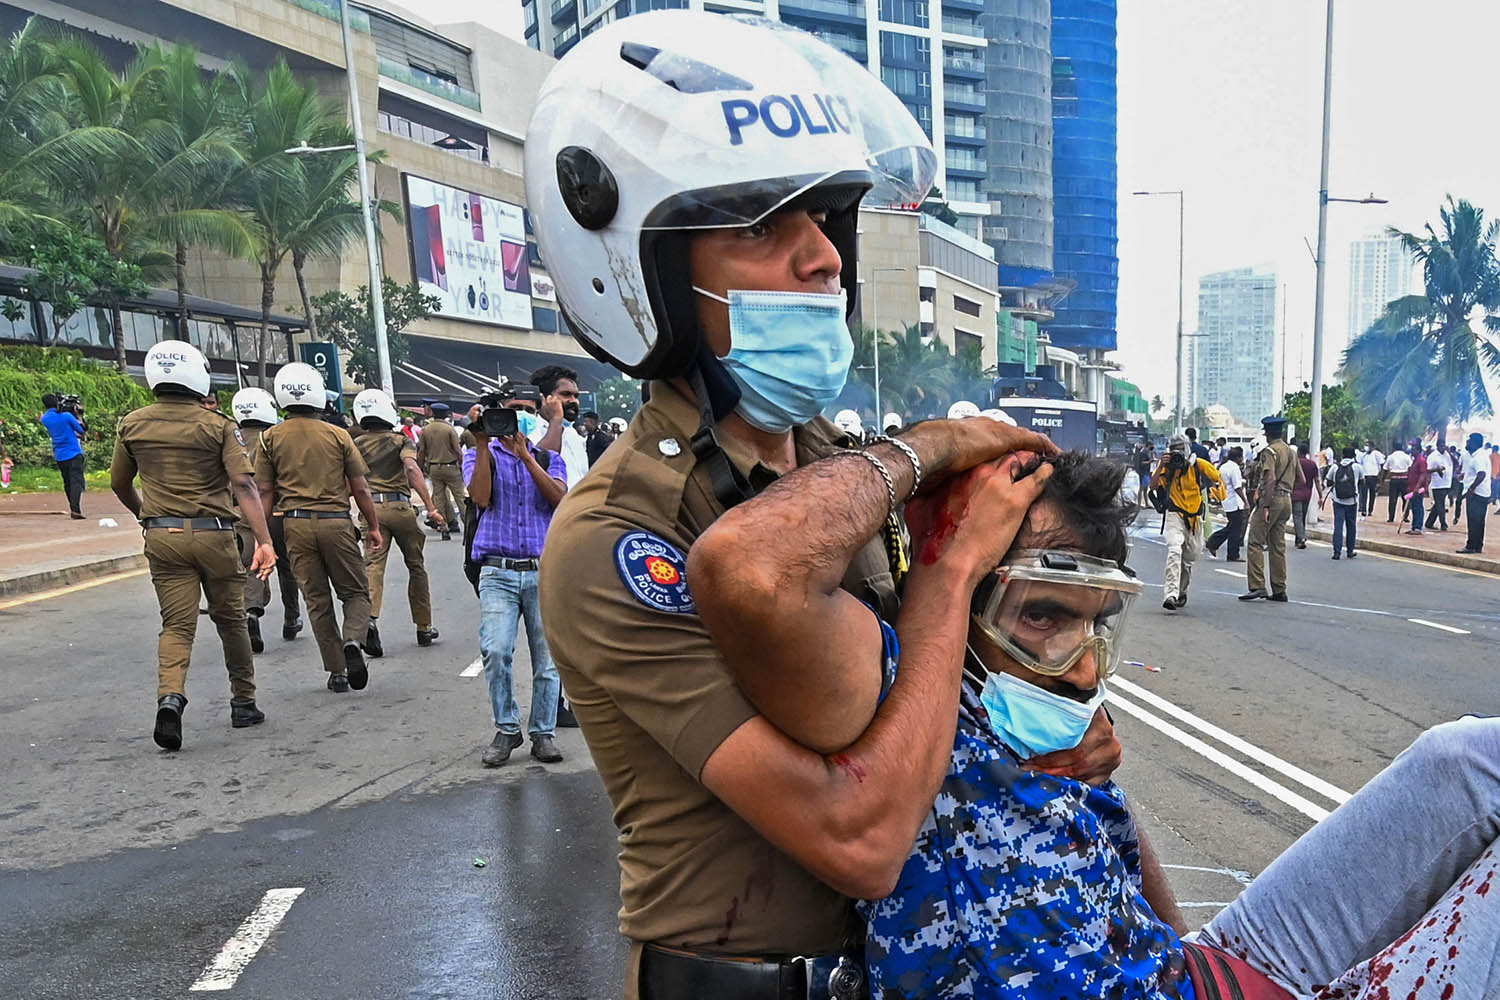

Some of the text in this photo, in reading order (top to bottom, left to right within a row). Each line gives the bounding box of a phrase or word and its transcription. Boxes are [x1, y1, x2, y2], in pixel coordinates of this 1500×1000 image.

[721, 94, 852, 146] POLIC
[447, 238, 497, 272] NEW
[151, 352, 188, 363] POLICE
[281, 383, 312, 391] POLICE
[235, 402, 258, 410] POLICE
[1032, 417, 1063, 428] POLICE
[634, 574, 673, 604] POLICE
